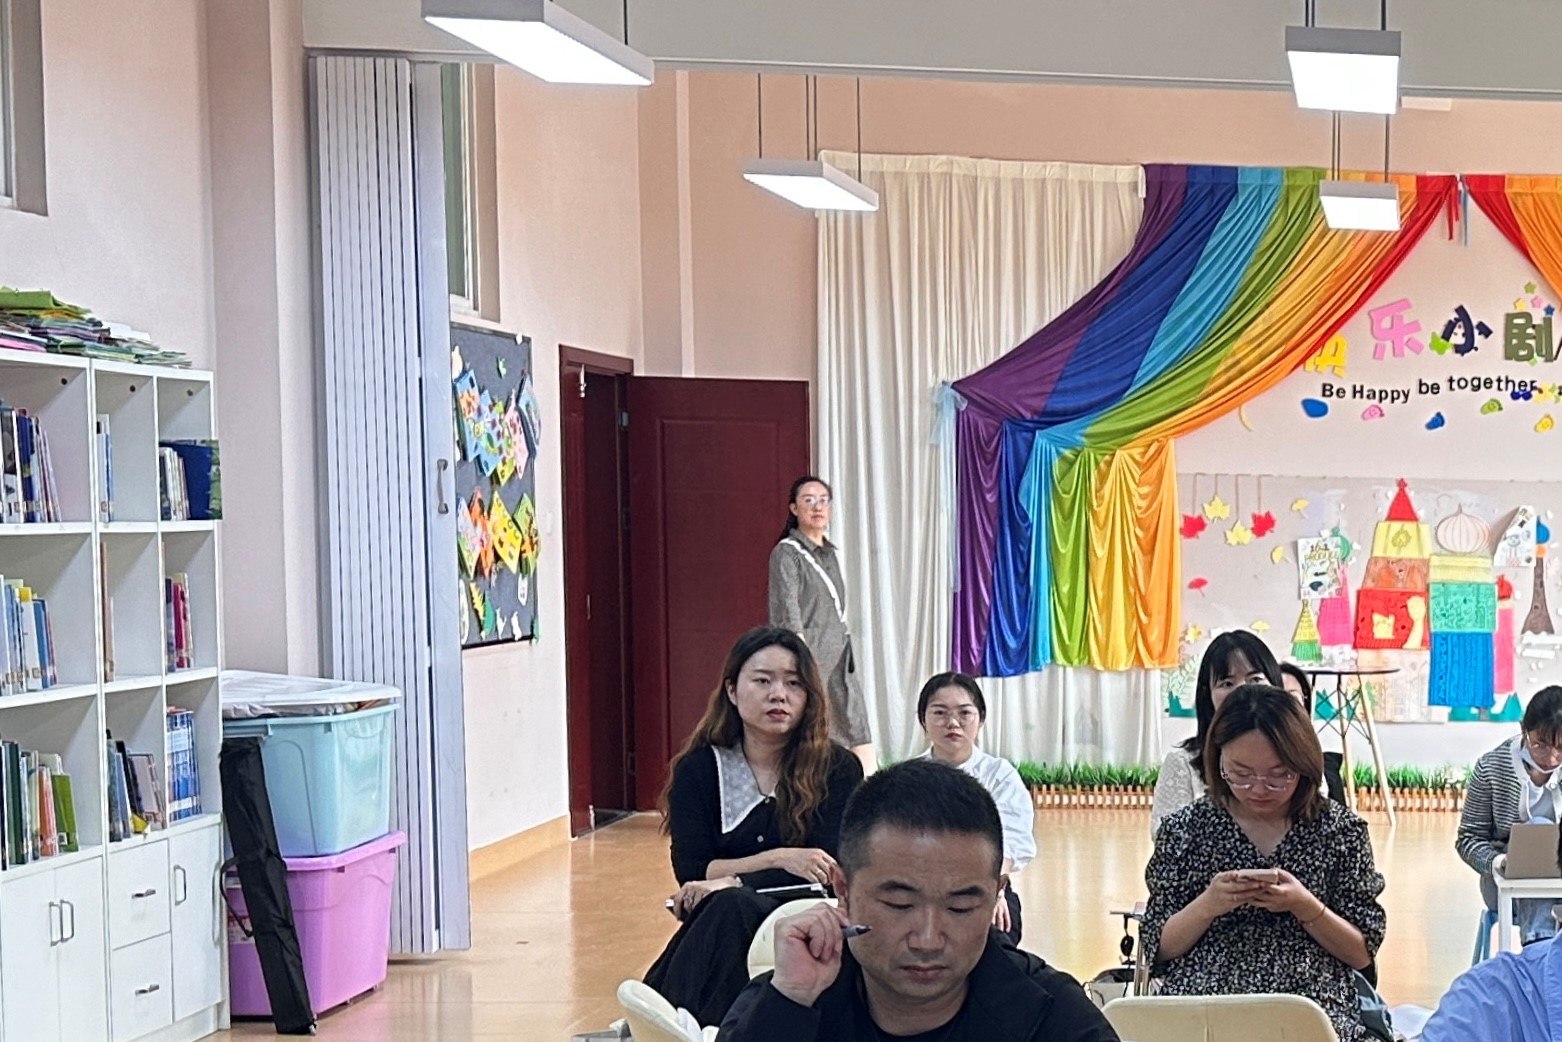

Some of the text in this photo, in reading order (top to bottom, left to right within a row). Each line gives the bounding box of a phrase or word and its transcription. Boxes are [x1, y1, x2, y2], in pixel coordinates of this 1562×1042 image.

[1321, 376, 1537, 404] Be Happy be together
